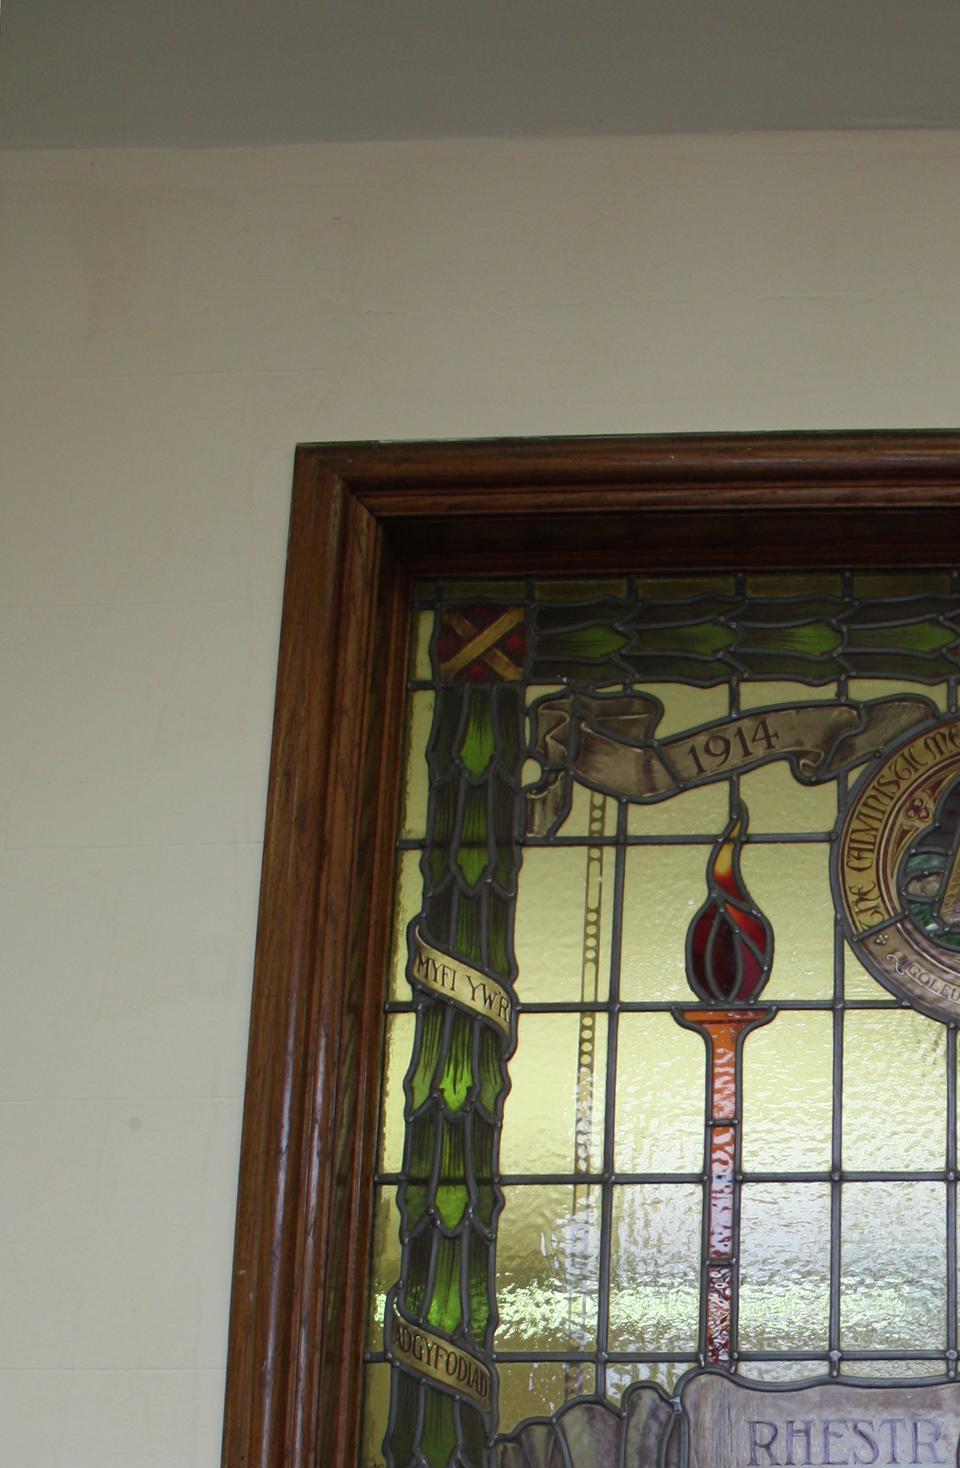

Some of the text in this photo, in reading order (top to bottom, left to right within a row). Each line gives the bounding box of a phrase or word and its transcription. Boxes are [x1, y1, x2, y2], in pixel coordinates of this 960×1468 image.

[687, 718, 780, 777] 1914
[846, 749, 927, 873] CALVINISTIC
[417, 952, 457, 992] MYFI
[747, 1417, 947, 1467] RHESTR
